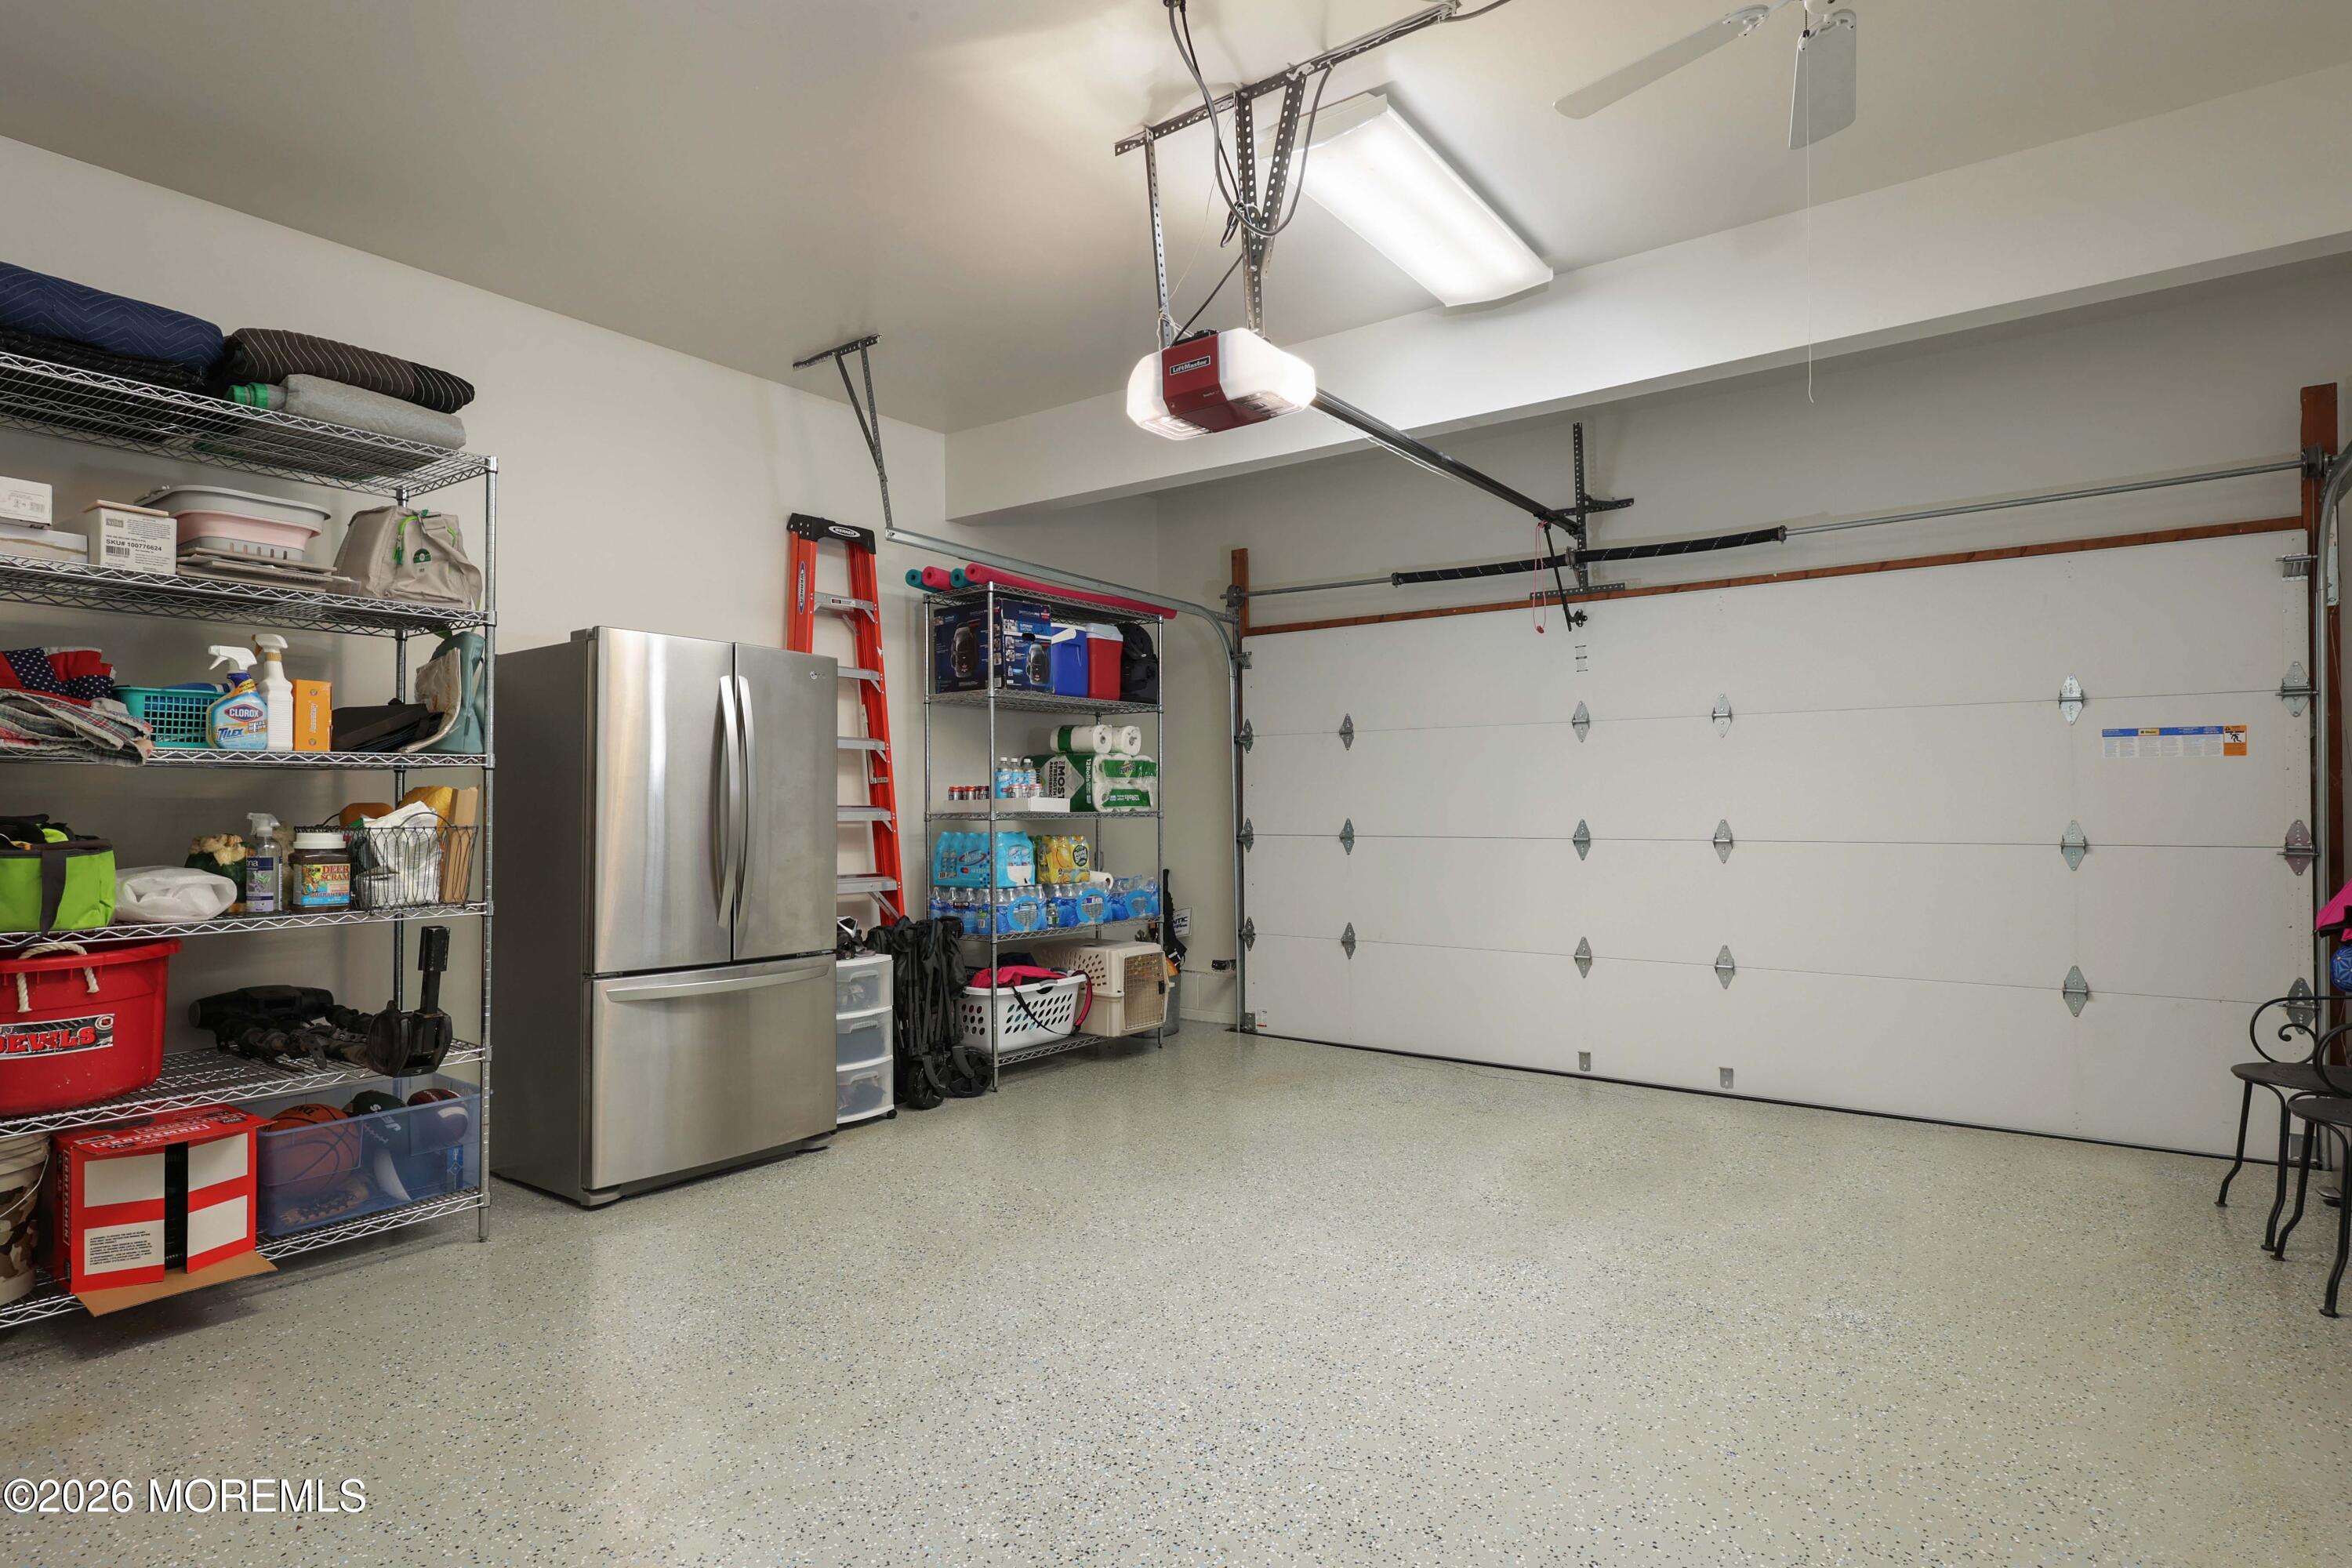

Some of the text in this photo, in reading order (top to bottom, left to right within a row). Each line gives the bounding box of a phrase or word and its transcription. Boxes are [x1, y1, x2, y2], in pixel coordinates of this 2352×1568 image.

[1172, 360, 1207, 373] LiftMaster
[229, 708, 259, 717] CLOROX
[321, 865, 350, 873] DEER
[321, 873, 350, 881] SCRAM
[1173, 916, 1188, 924] NTIC
[100, 1125, 199, 1147] CRAFTSMAN
